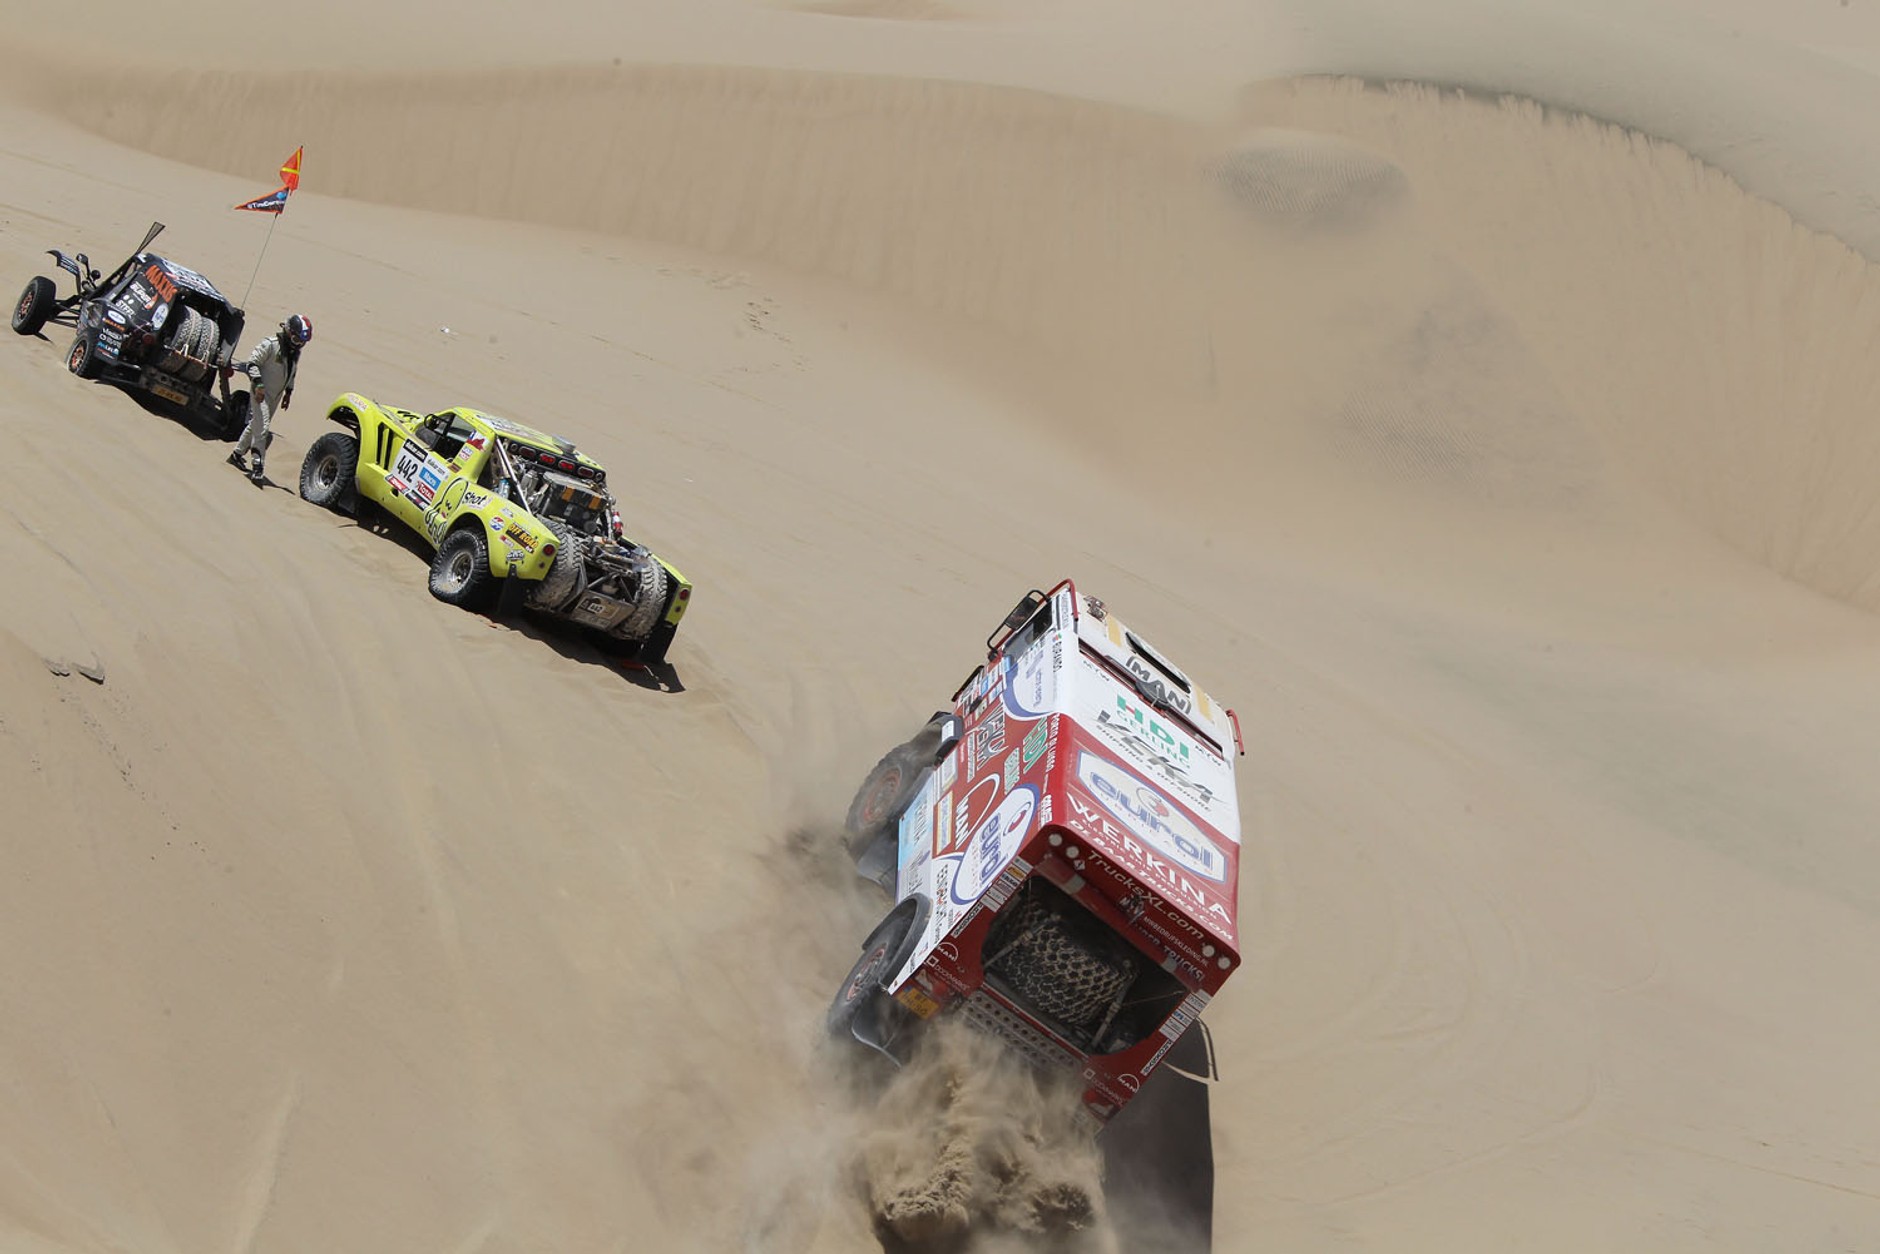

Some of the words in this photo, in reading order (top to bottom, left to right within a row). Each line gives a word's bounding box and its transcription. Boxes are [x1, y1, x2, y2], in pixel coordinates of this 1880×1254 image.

[145, 265, 177, 302] MAXXIS
[397, 455, 418, 483] 442
[509, 523, 522, 535] OFF
[519, 532, 538, 548] ROAD
[1129, 659, 1189, 711] MAN
[1022, 715, 1048, 775] HDI
[1097, 709, 1213, 804] VEKA
[1115, 709, 1190, 769] GERLING
[1116, 694, 1190, 759] HDI
[1096, 725, 1143, 764] SHIPPING
[1156, 771, 1212, 812] OFFSHORE
[954, 796, 971, 850] MAN
[979, 812, 1008, 887] eurol
[1090, 770, 1213, 871] eurol
[1066, 791, 1232, 925] WERKINA
[1088, 850, 1204, 940] TrucksXL.com
[938, 945, 956, 962] MAN
[1120, 1078, 1137, 1093] MAN
